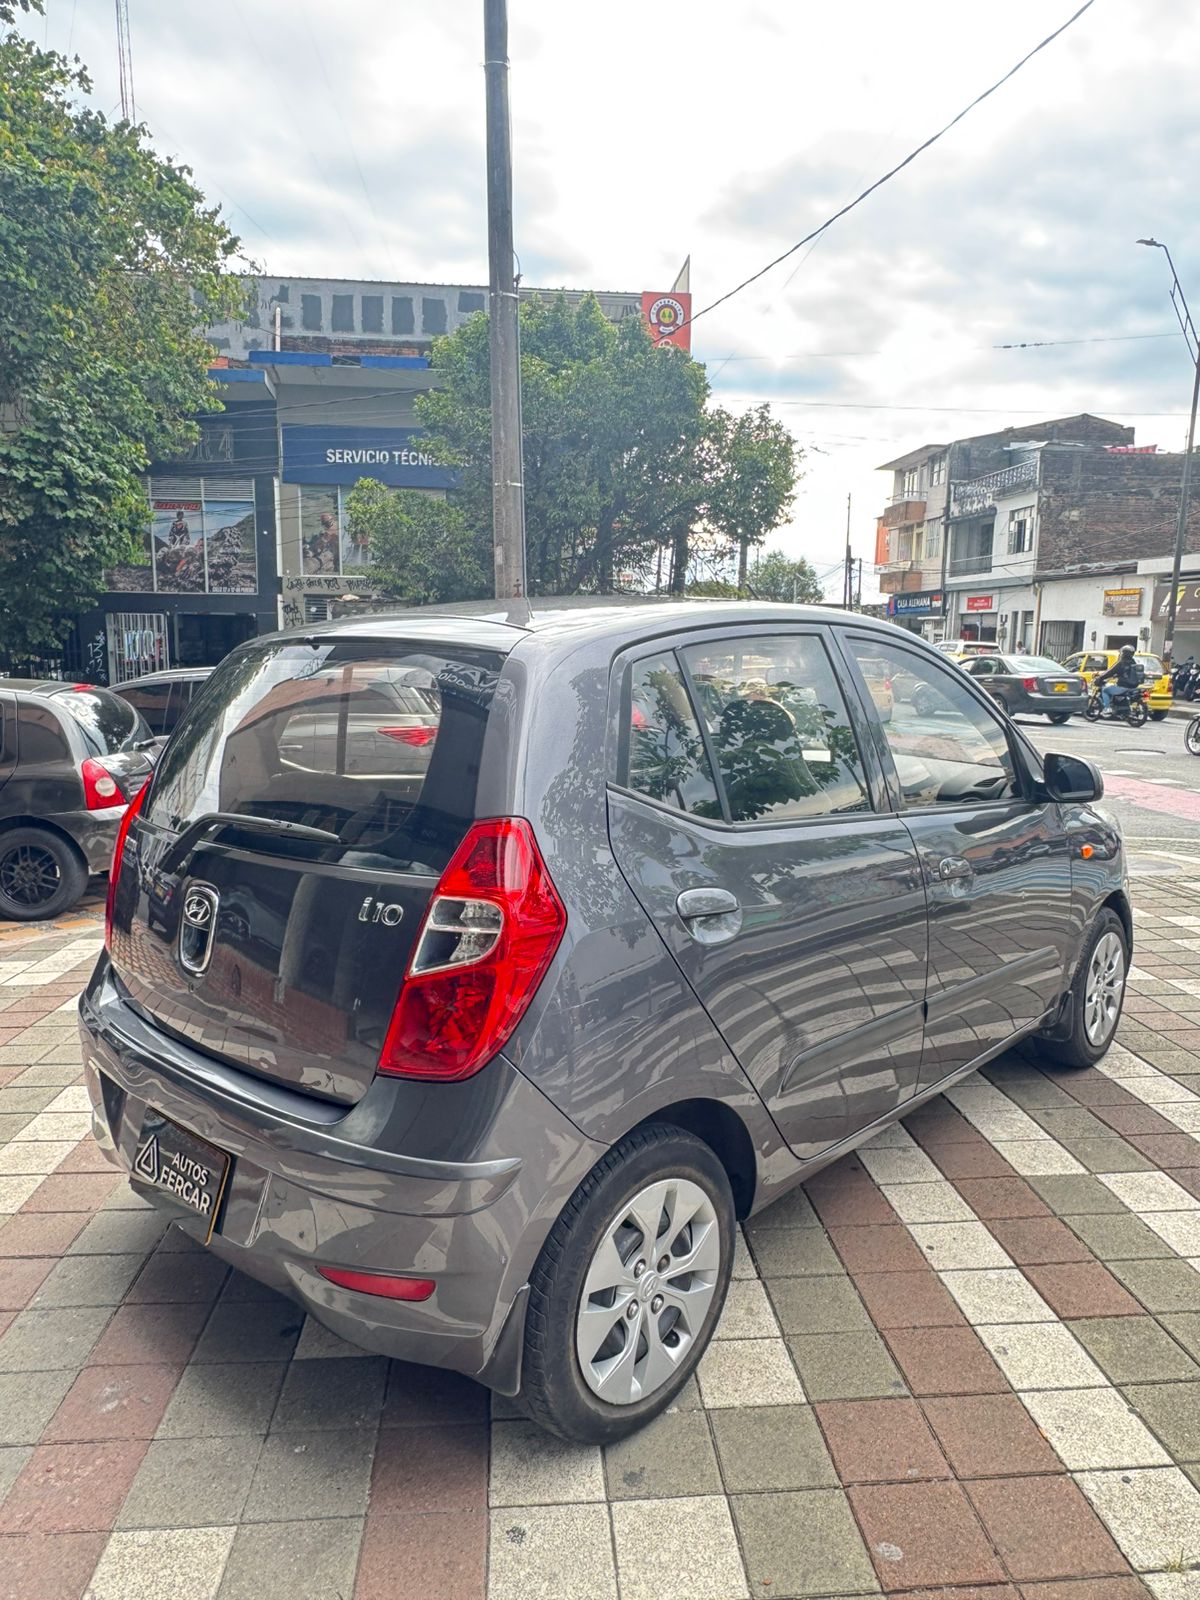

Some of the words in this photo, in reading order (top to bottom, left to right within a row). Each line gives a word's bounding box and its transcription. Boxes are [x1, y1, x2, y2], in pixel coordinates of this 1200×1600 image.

[326, 448, 389, 464] SERVICIO
[897, 599, 908, 608] CASA
[908, 596, 930, 608] ALEMANA
[358, 896, 404, 926] i10
[171, 1151, 209, 1187] AUTOS
[159, 1164, 212, 1215] FERCAR
